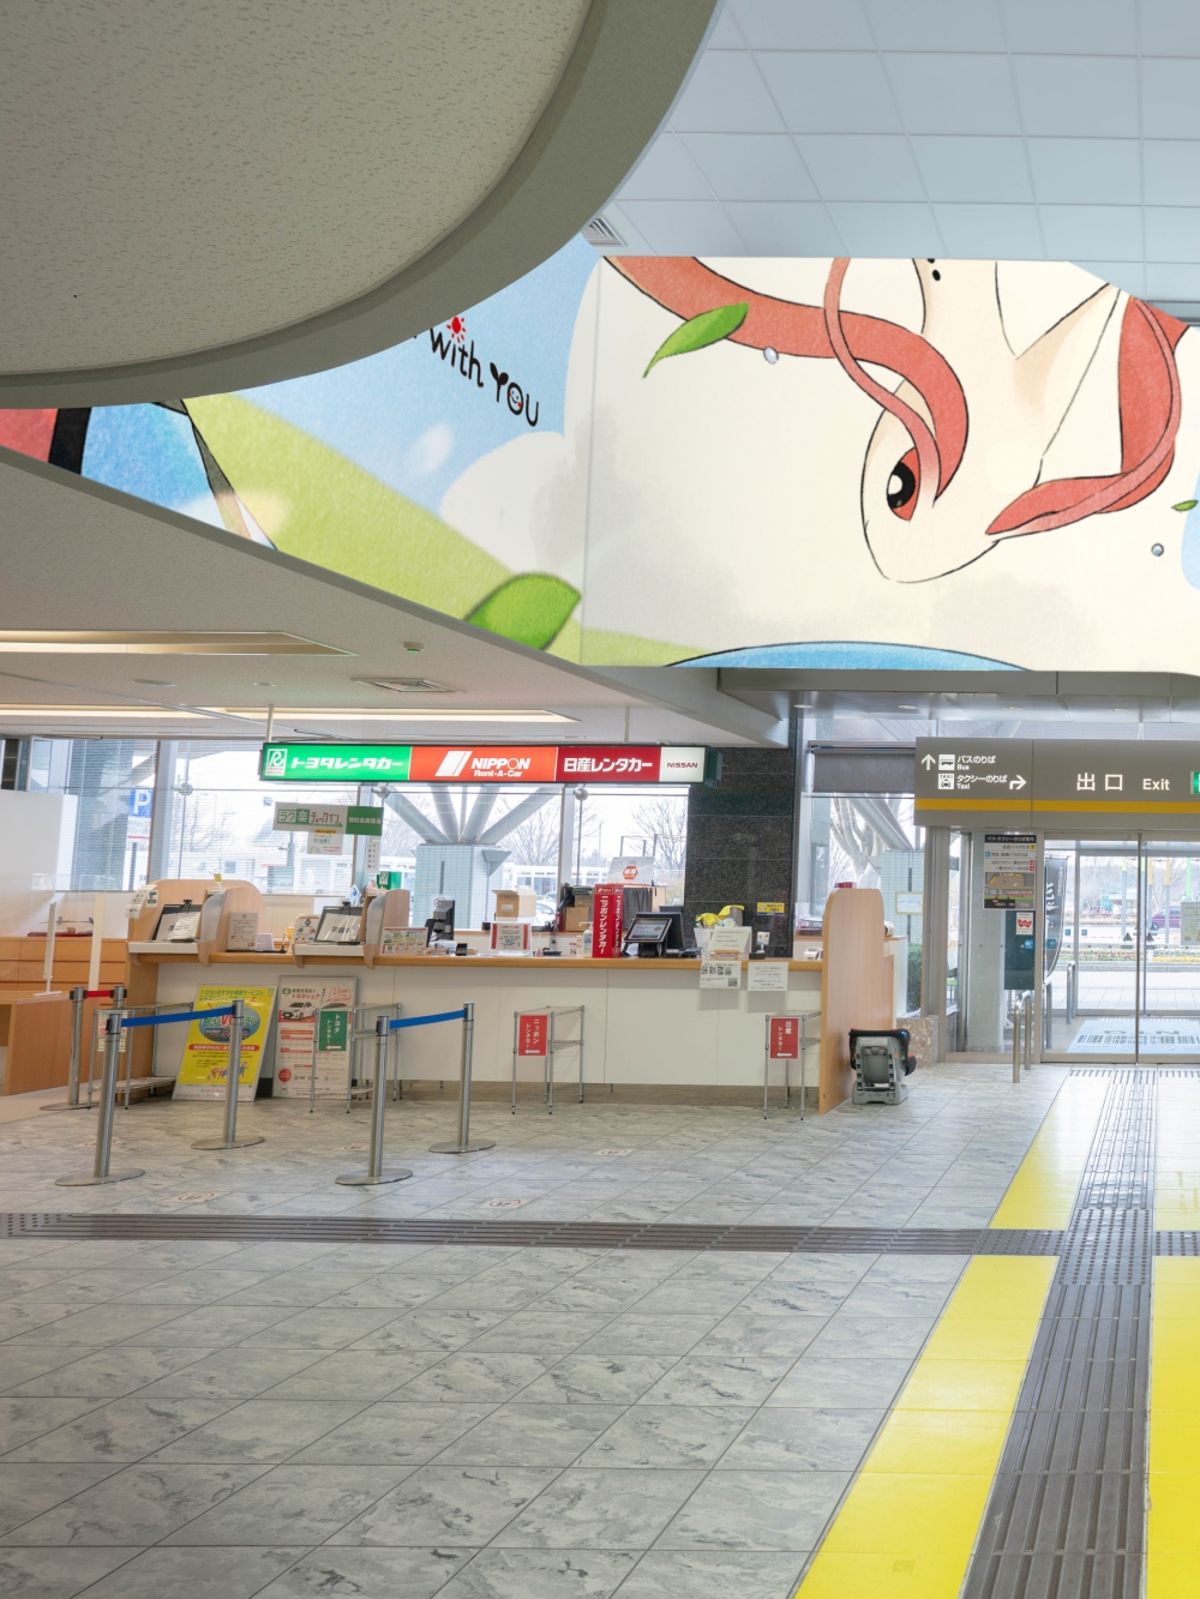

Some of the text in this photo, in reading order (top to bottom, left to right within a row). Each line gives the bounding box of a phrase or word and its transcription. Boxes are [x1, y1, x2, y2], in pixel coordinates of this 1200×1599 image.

[291, 757, 403, 770] トヨタレンタカー
[471, 757, 531, 770] NIPPON
[564, 757, 653, 772] 日産レンタカー
[957, 755, 997, 764] バスのりば
[474, 769, 523, 777] Rent-A-Car
[956, 774, 1008, 784] タクシーのりば
[1076, 772, 1123, 791] 出口
[1142, 778, 1170, 791] Exit
[133, 789, 151, 814] P
[532, 1018, 540, 1044] ニッポン
